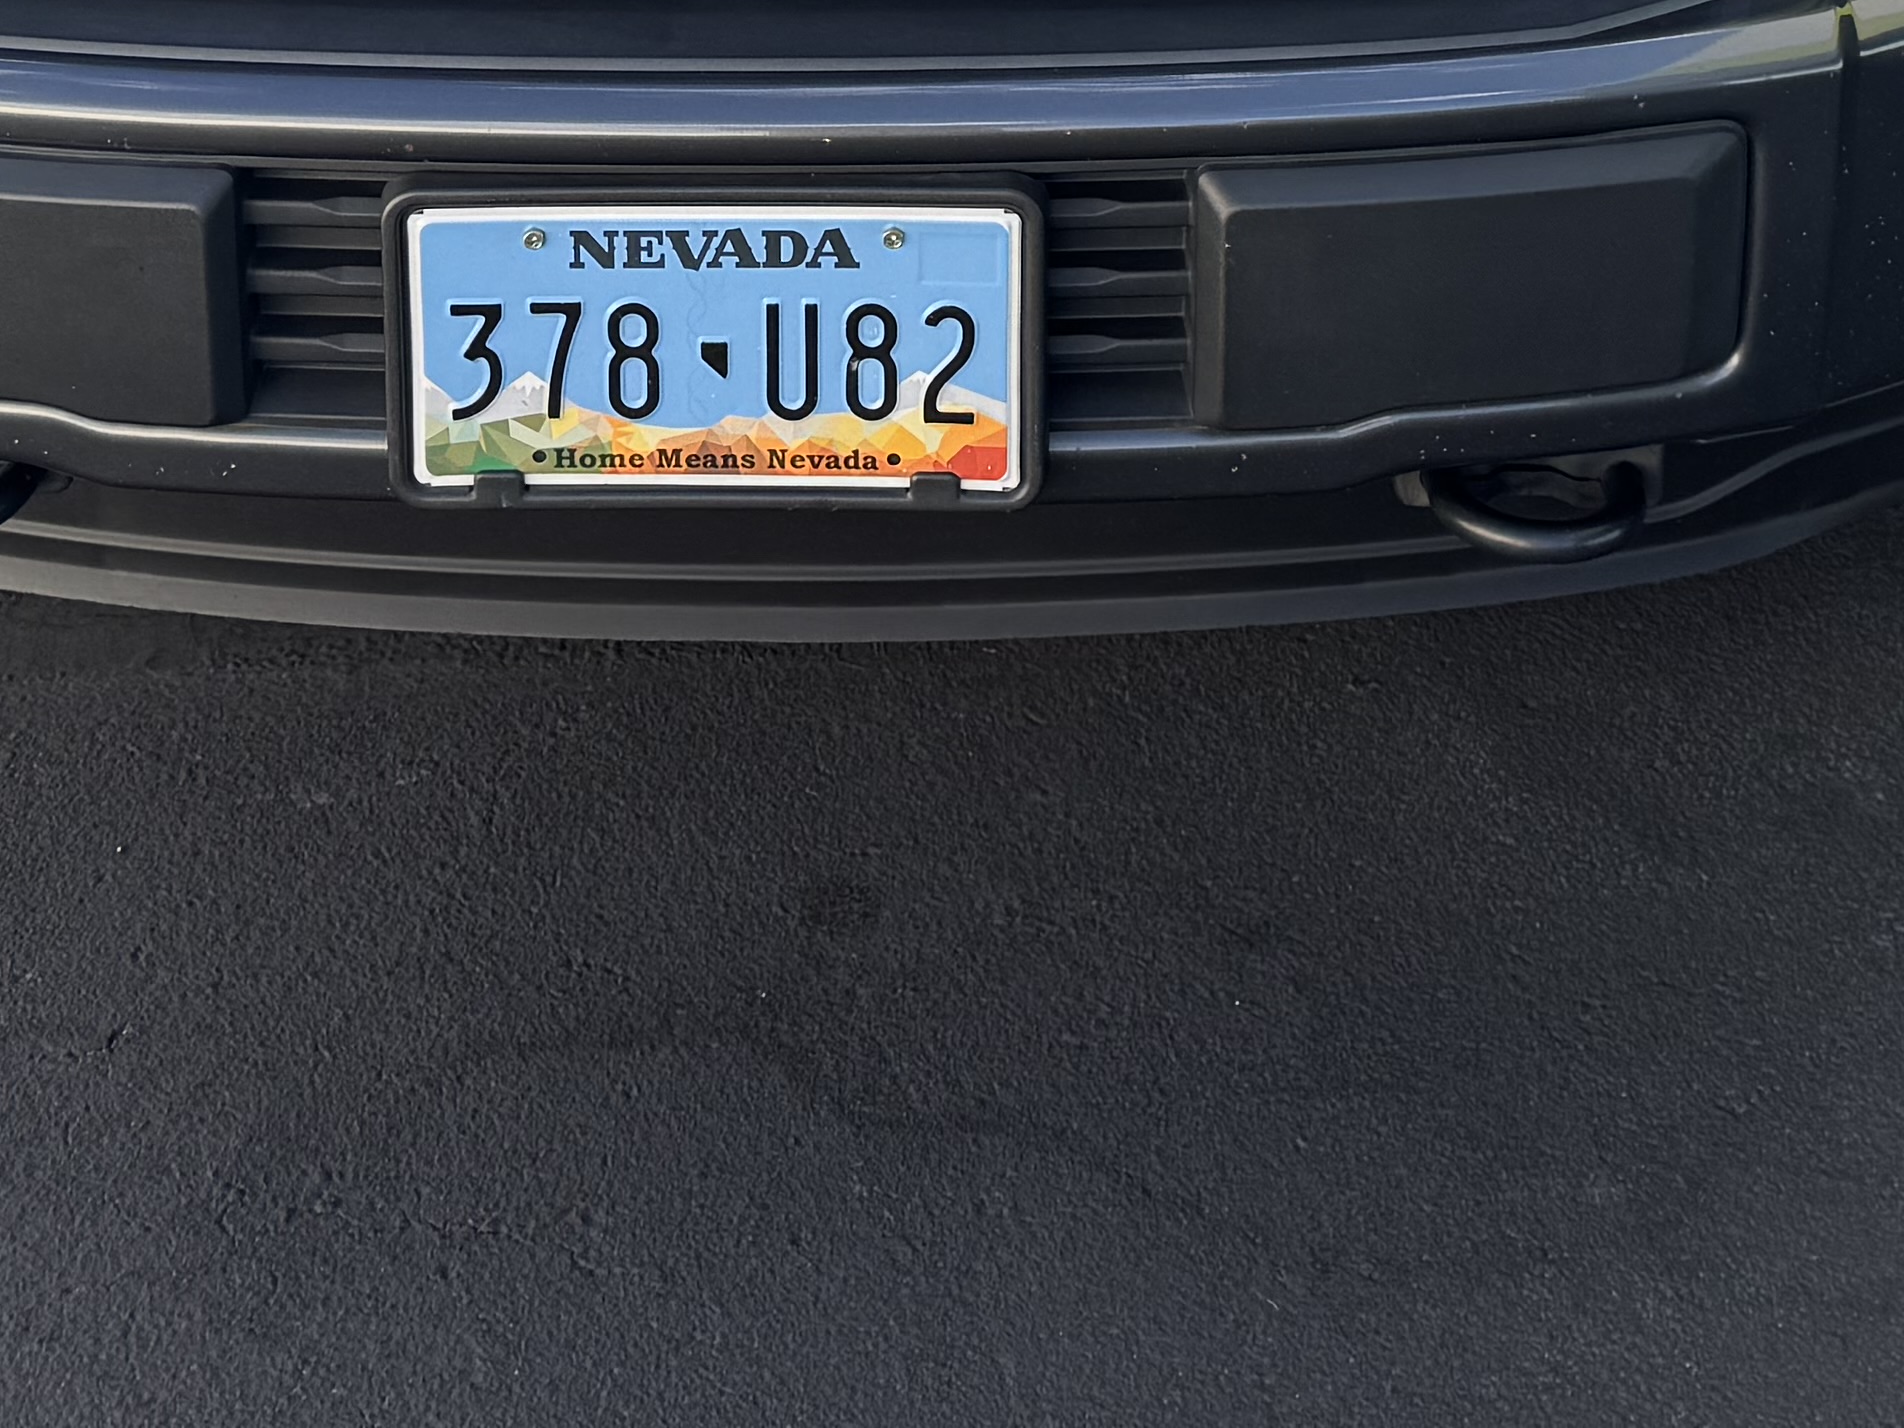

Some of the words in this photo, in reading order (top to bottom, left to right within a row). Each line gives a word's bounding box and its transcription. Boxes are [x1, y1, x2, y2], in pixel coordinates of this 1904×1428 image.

[569, 229, 861, 271] NEVADA
[449, 302, 661, 421] 378
[765, 302, 976, 425] U82
[553, 446, 645, 471] Home
[655, 447, 756, 471] Means
[767, 448, 879, 472] Nevada
